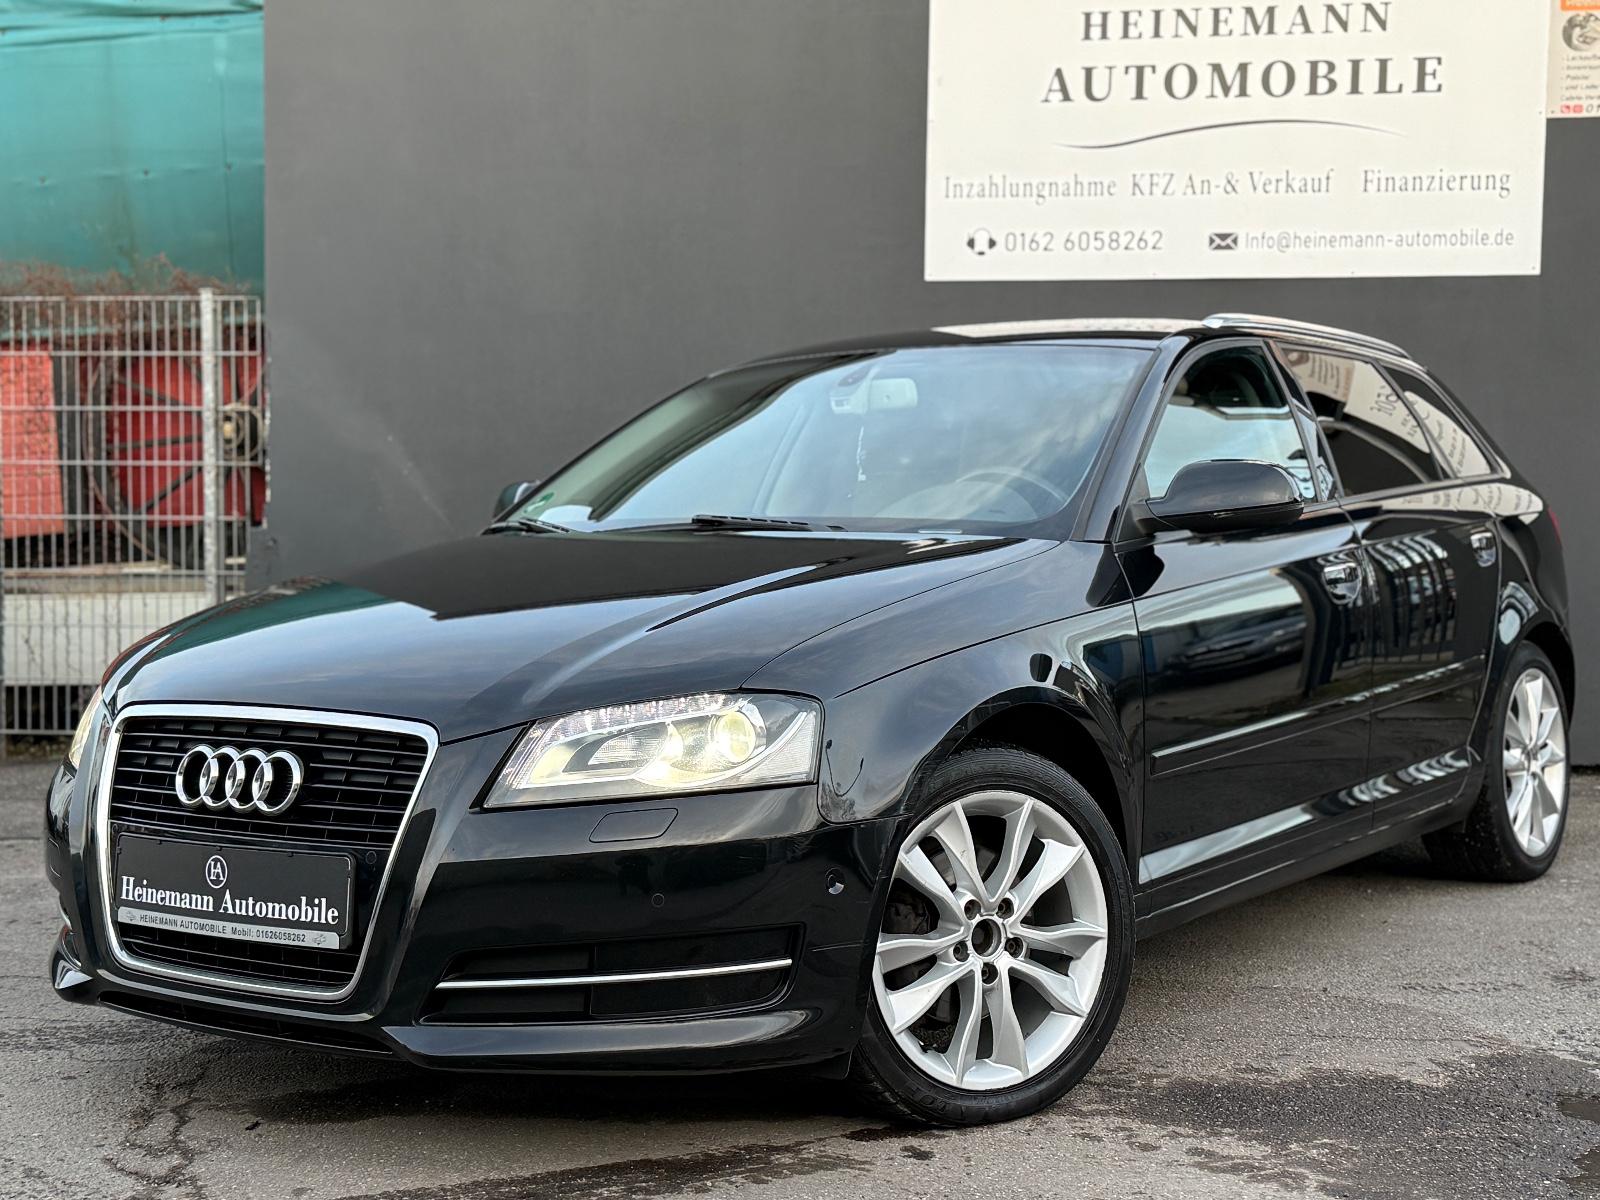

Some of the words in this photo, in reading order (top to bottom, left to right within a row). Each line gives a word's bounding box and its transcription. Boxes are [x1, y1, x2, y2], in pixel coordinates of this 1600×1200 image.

[1081, 2, 1392, 41] HEINEMANN
[1041, 57, 1443, 103] AUTOMOBILE
[945, 173, 1118, 206] Inzahlungnahme
[1131, 172, 1175, 197] KFZ
[1249, 168, 1334, 195] Verkauf
[1362, 168, 1512, 199] Finanzierung
[1004, 231, 1055, 252] 0162
[1063, 230, 1164, 252] 6058262
[1245, 229, 1515, 253] Info@heinemann-automobile.de
[121, 876, 214, 911] Heinemann
[219, 889, 339, 925] Automobile
[139, 914, 178, 928] HEINEMANN
[180, 919, 227, 934] AUTOMOBILE
[231, 926, 254, 939] Mobil:
[256, 929, 306, 943] 01626058262
